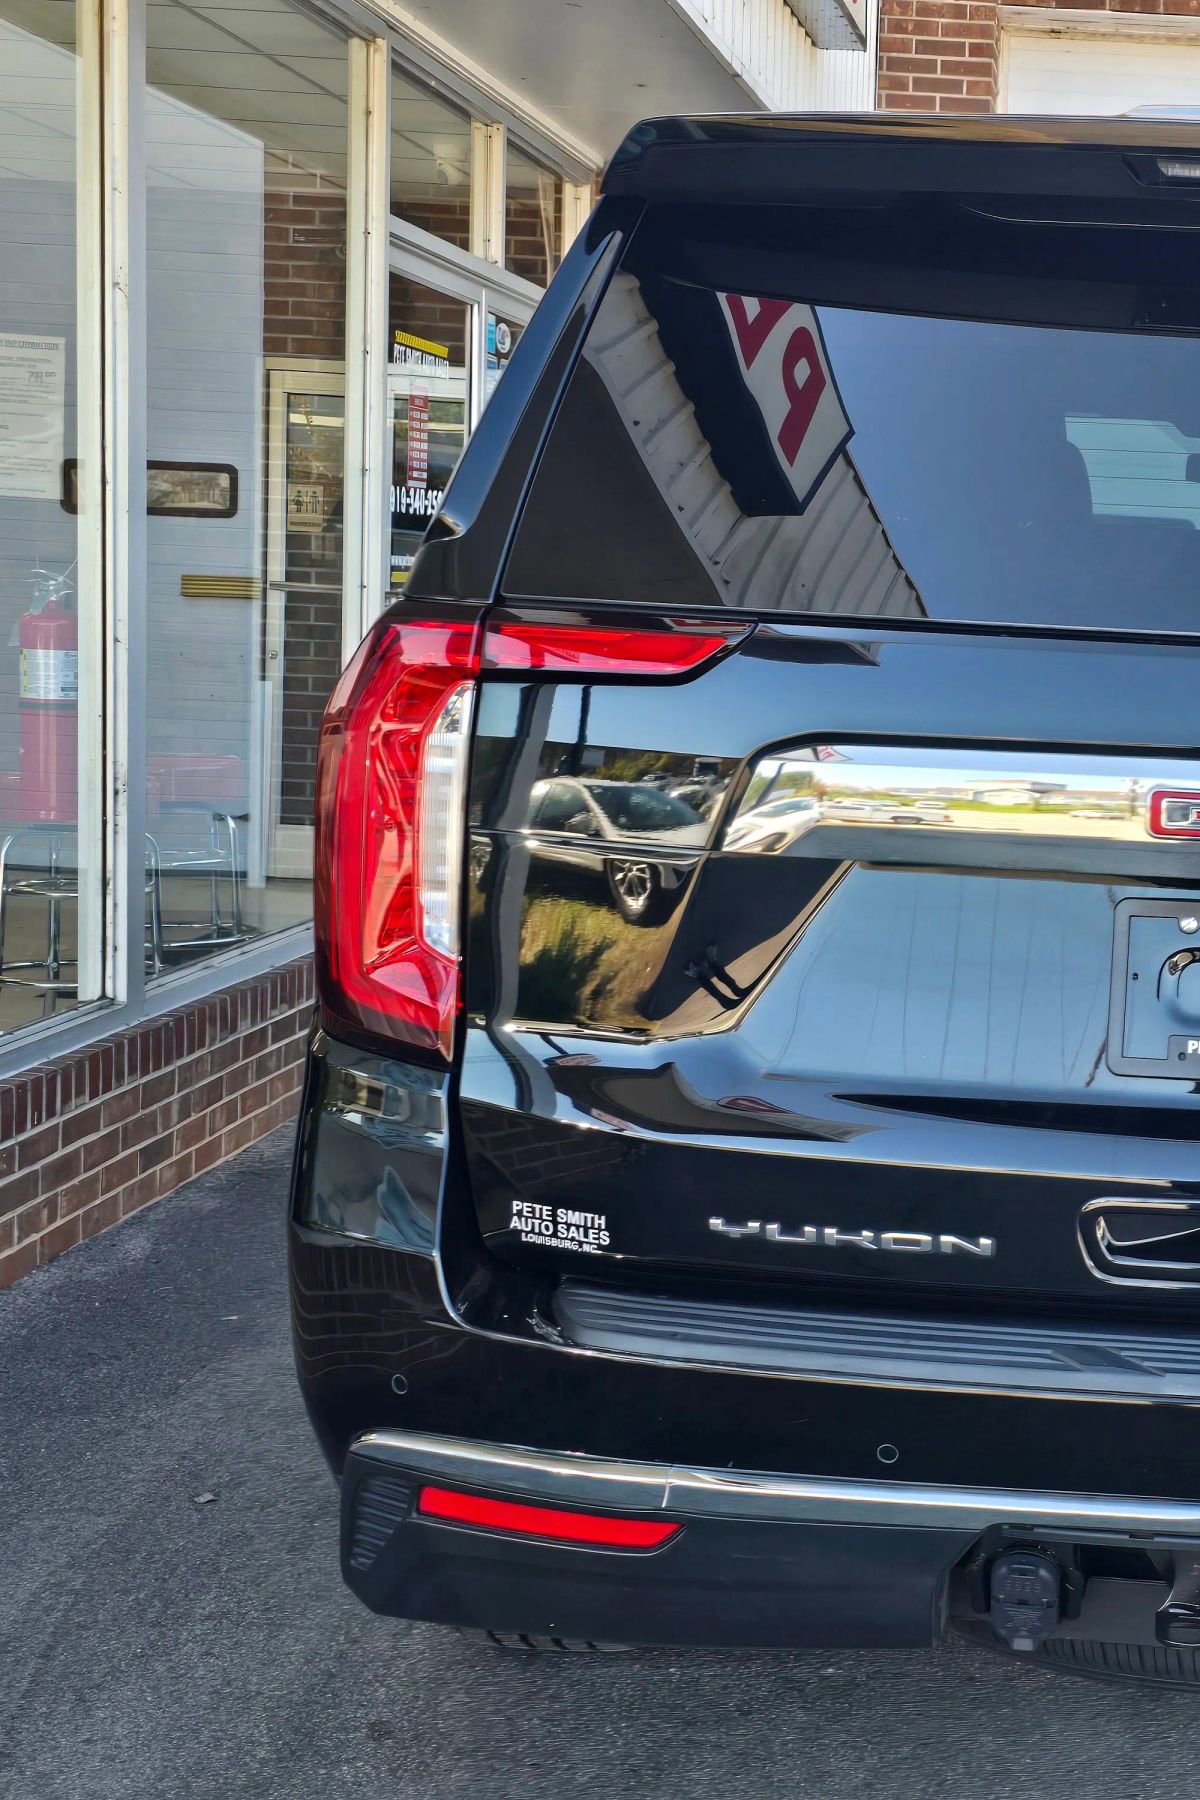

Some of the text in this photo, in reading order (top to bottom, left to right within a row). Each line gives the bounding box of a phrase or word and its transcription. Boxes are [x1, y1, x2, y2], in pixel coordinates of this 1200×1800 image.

[510, 1215, 610, 1246] AUTO SALES
[512, 1200, 606, 1230] PETE SMITH
[708, 1217, 997, 1257] YUKON
